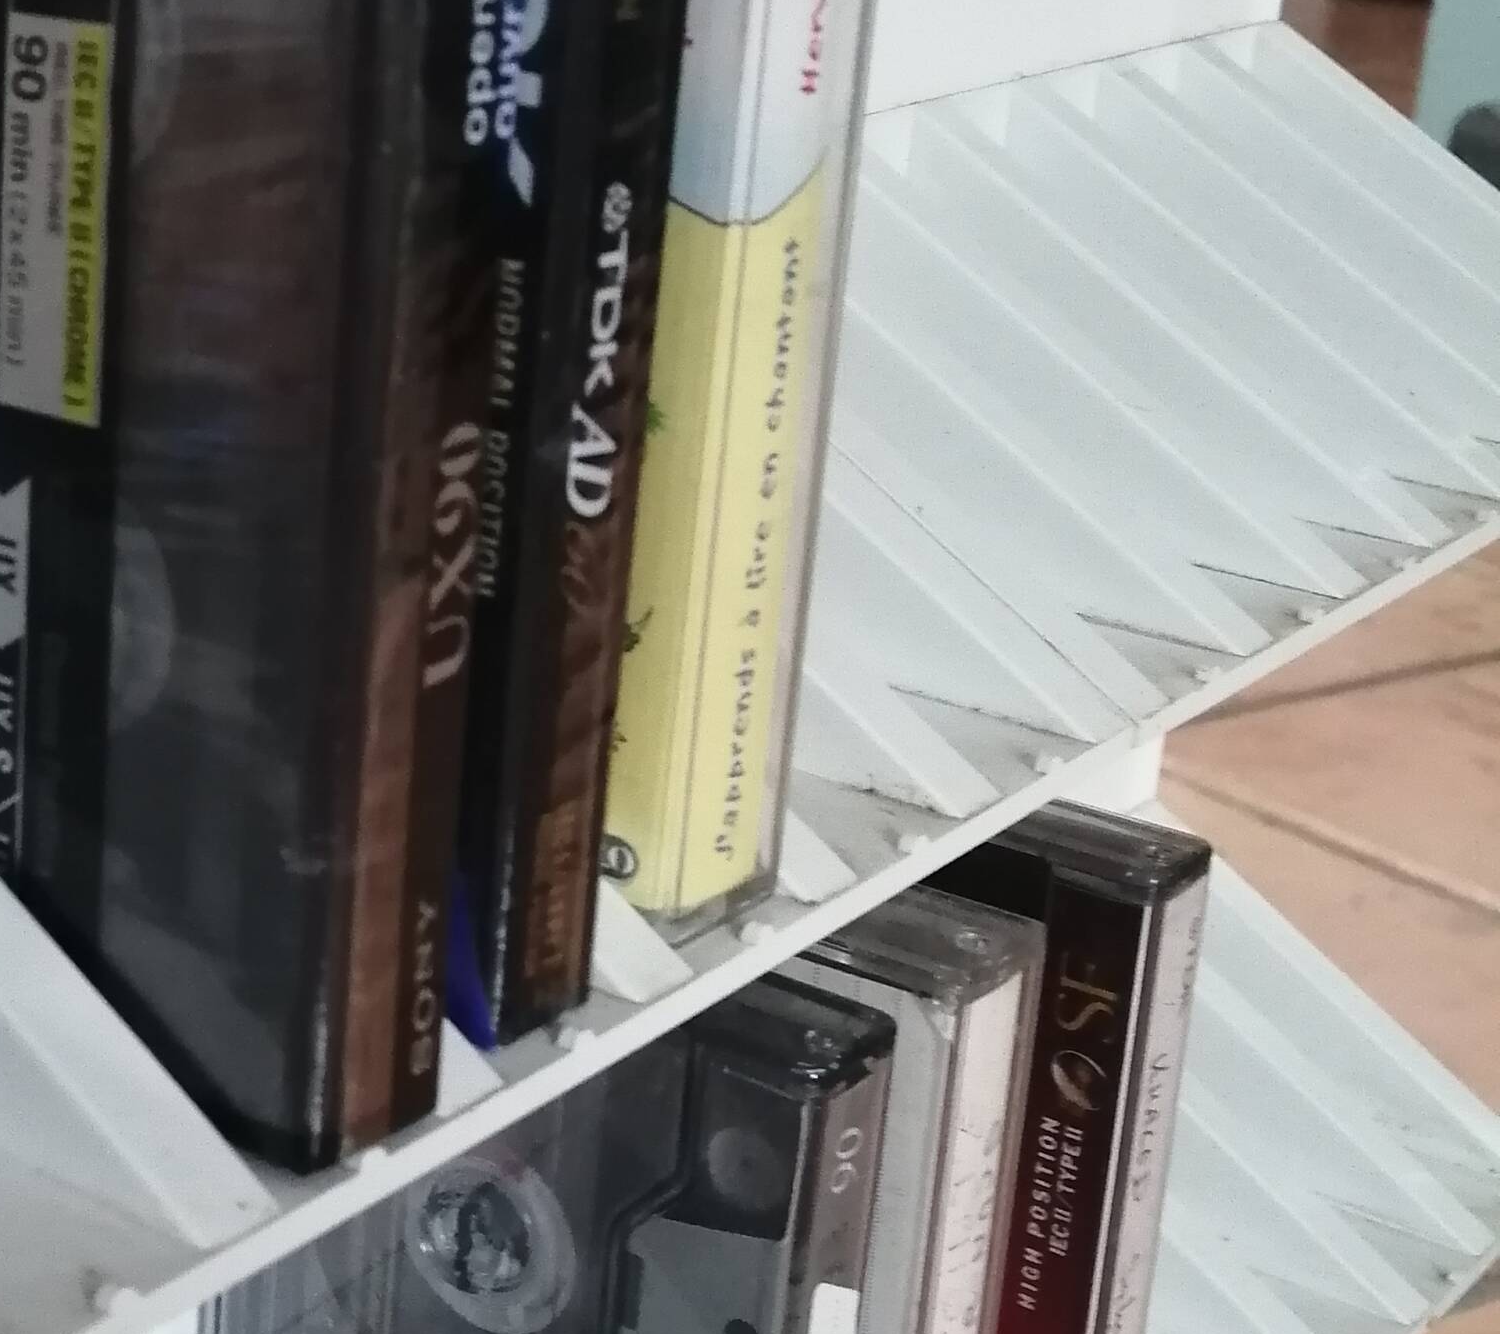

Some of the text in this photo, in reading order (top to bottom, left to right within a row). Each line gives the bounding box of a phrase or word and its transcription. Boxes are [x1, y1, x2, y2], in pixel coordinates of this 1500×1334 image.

[11, 33, 49, 102] 90
[10, 112, 35, 183] min
[586, 231, 628, 396] TDK
[763, 238, 803, 434] chantant
[566, 404, 619, 520] AD
[758, 447, 779, 500] en
[421, 421, 482, 690] UX90
[747, 519, 772, 596] lire
[409, 897, 438, 1079] SONY
[1017, 1115, 1062, 1311] HIGH POSITION
